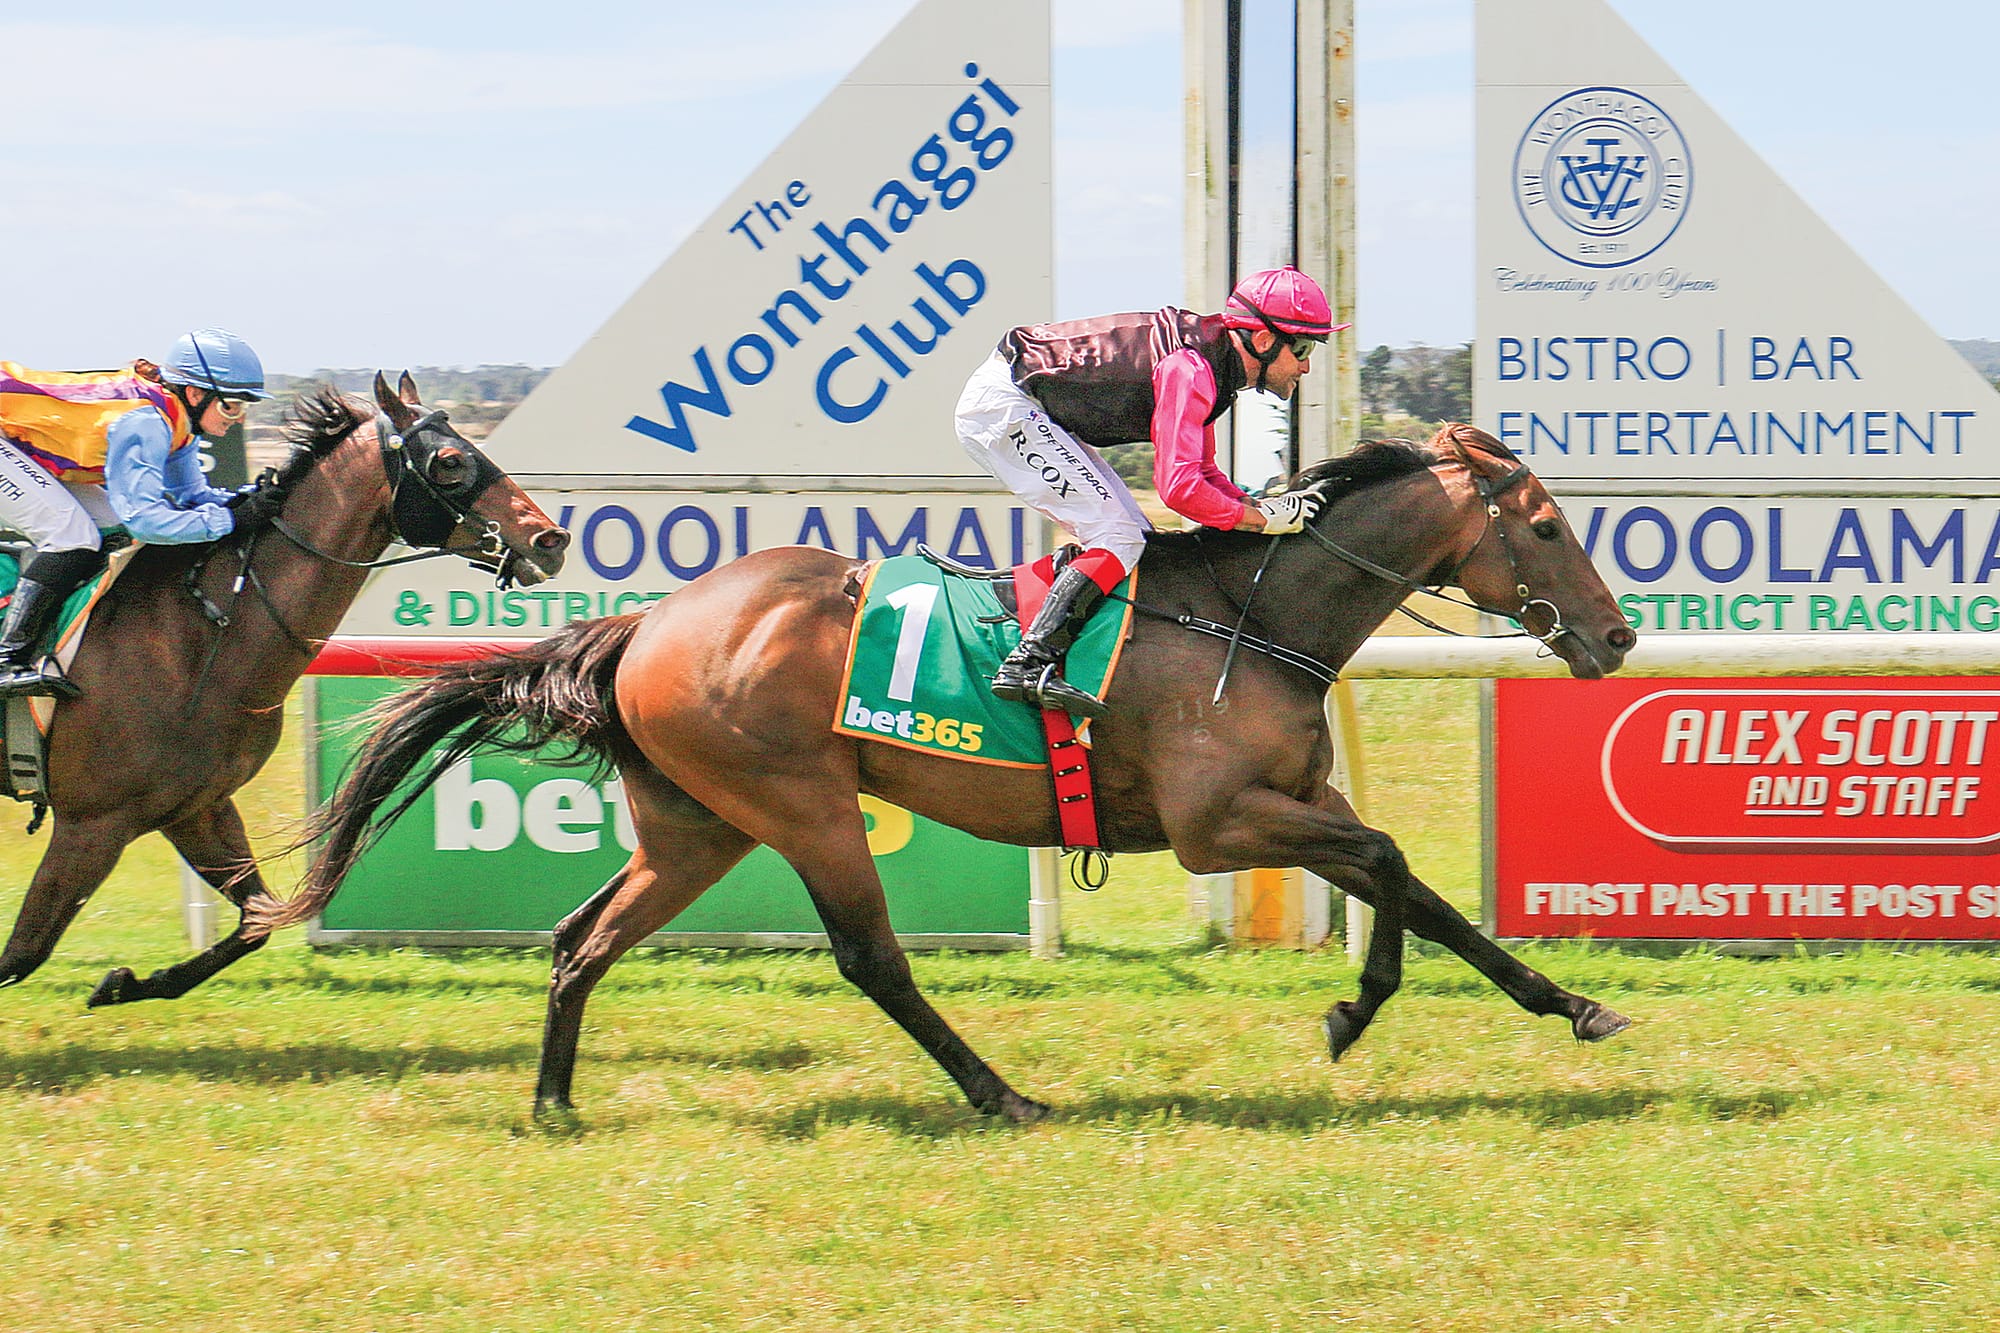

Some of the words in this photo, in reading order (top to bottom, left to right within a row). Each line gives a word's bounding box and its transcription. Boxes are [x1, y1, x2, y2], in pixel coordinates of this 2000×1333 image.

[728, 180, 812, 251] The
[624, 62, 1021, 453] Wonthaggi
[1493, 266, 1599, 300] Celebrating
[1606, 272, 1650, 291] 100
[1656, 266, 1719, 298] Years
[815, 259, 986, 424] Club
[1497, 337, 1691, 381] BISTRO
[1750, 337, 1862, 380] BAR
[1499, 411, 1977, 455] ENTERTAINMENT
[0, 474, 25, 501] ITH
[14, 458, 52, 489] TRACK
[1009, 428, 1079, 499] R.COX
[1037, 424, 1057, 446] OFF
[1056, 444, 1081, 466] THE
[1077, 465, 1113, 501] TRACK
[1584, 506, 2000, 584] OOLAM
[394, 590, 432, 627] &
[1618, 593, 1792, 631] STRICT
[1811, 594, 2000, 632] RACING
[886, 582, 939, 702] 1
[845, 695, 984, 752] bet365
[1661, 710, 1811, 764] ALEX
[1816, 710, 1999, 766] SCOTT
[1745, 776, 1829, 806] AND
[1835, 776, 1980, 817] STAFF
[1524, 883, 1645, 916] FIRST
[1650, 884, 1757, 917] PAST
[1762, 884, 1847, 918] THE
[1852, 885, 1963, 919] POST
